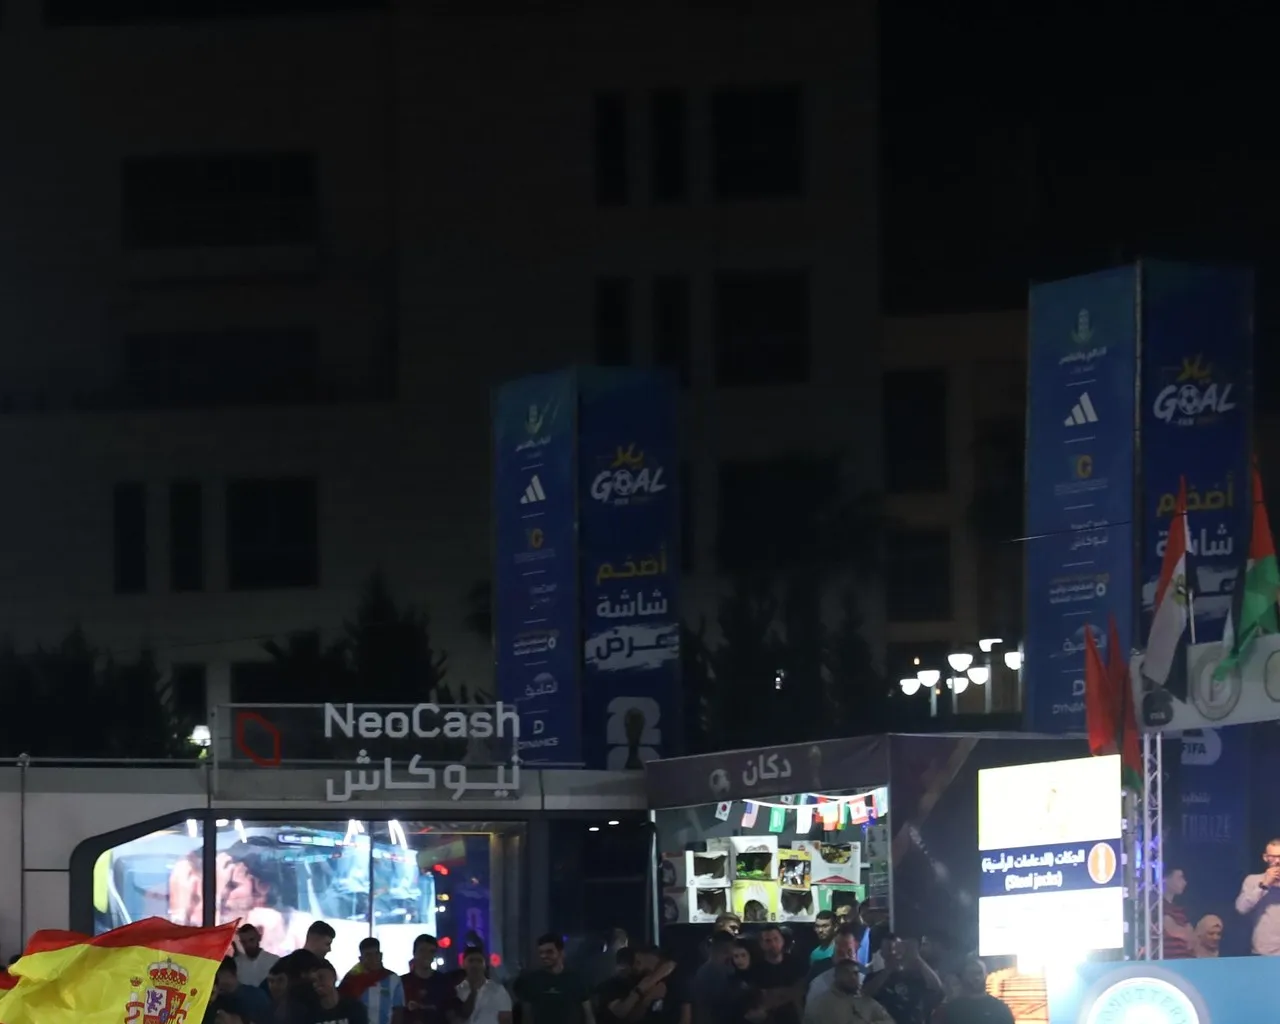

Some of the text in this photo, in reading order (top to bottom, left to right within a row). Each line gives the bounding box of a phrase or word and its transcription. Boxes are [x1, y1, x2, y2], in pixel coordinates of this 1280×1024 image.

[1153, 382, 1237, 422] GOAL
[590, 467, 668, 503] GOAL
[596, 589, 669, 618] شاشة
[323, 700, 521, 739] NeoCash
[325, 748, 521, 802] نيوكاش
[742, 754, 793, 786] دكان
